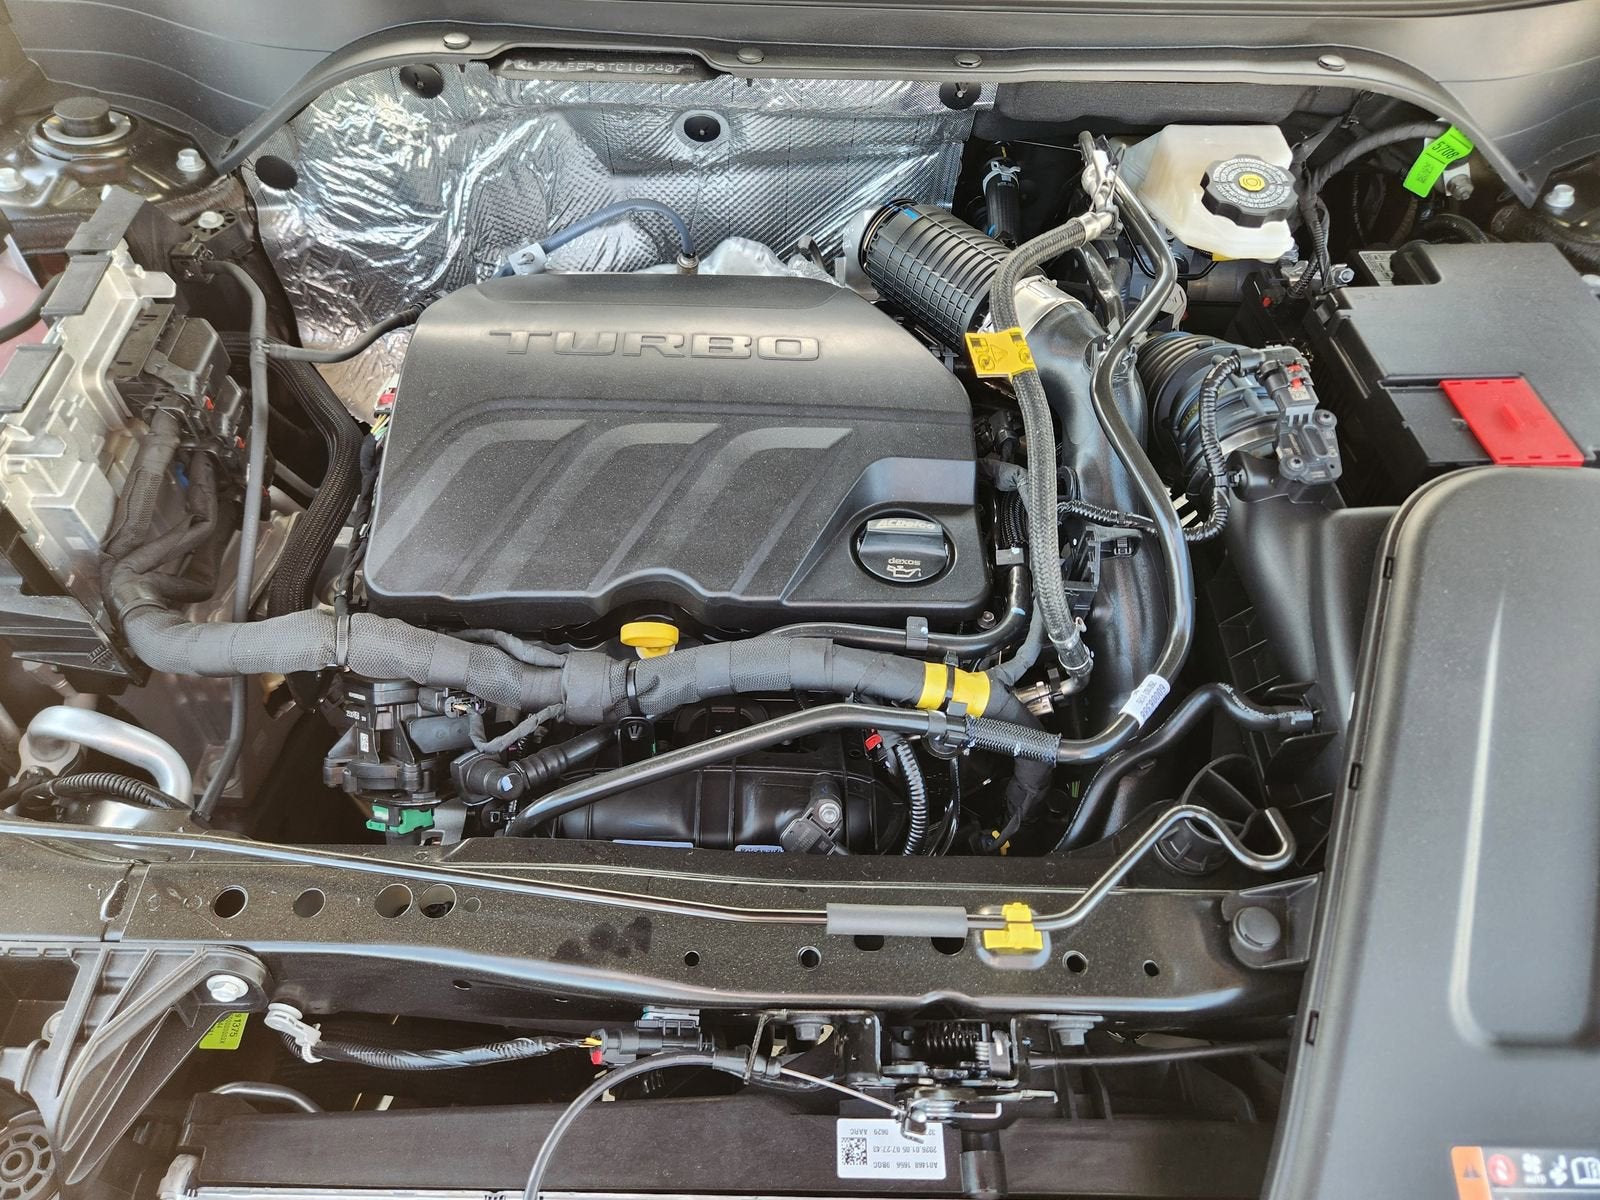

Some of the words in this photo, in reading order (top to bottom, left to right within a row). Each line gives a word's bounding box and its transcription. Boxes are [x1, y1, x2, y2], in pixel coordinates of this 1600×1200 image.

[1432, 141, 1459, 159] 5708
[489, 331, 820, 361] TURBO
[876, 519, 936, 529] ACDelco
[888, 557, 921, 566] dexos
